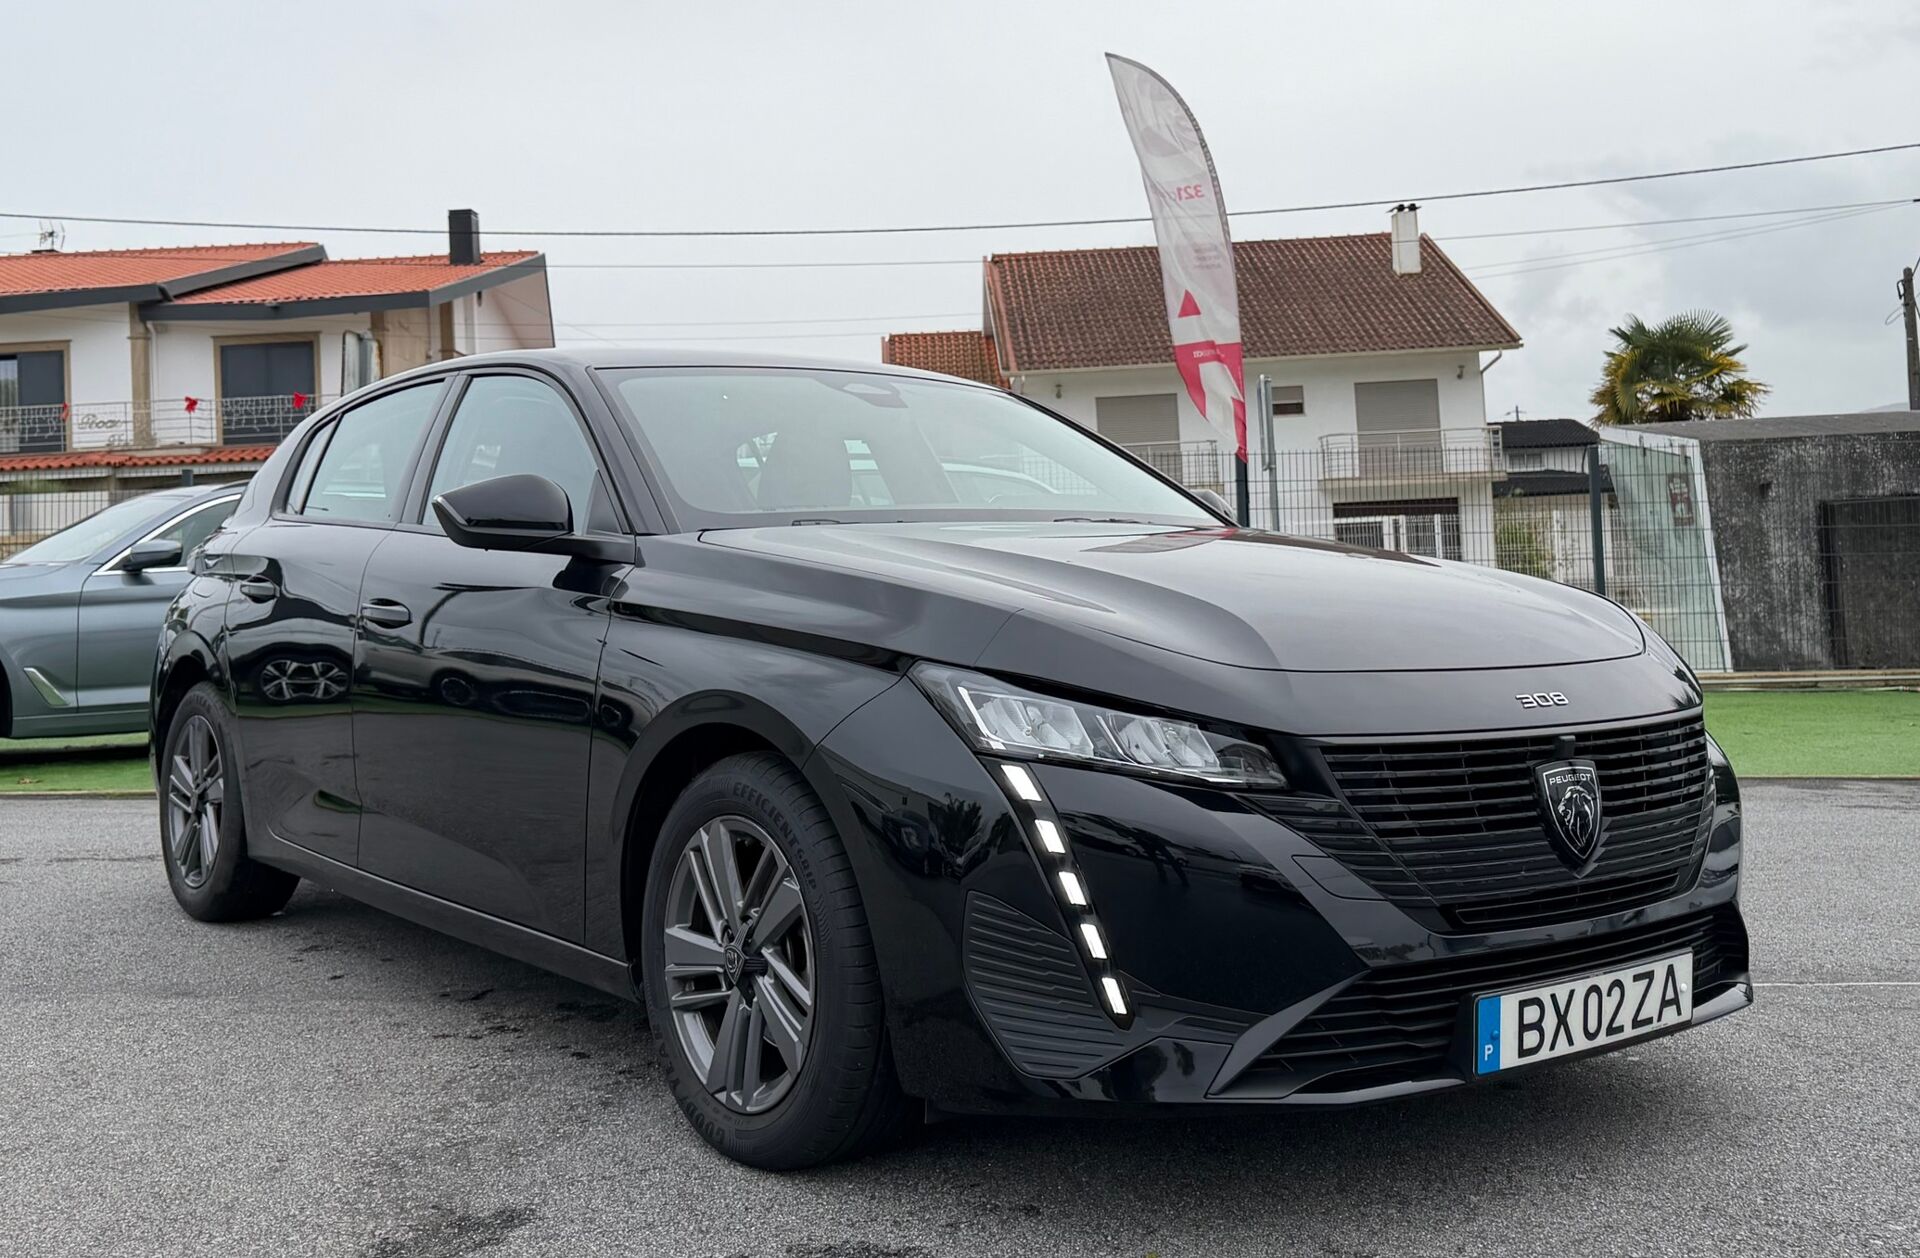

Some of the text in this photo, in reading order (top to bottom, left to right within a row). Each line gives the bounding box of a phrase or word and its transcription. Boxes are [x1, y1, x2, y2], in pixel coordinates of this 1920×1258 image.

[1516, 691, 1569, 709] 308
[1549, 773, 1592, 786] PEUGEOT
[1484, 1045, 1494, 1061] P
